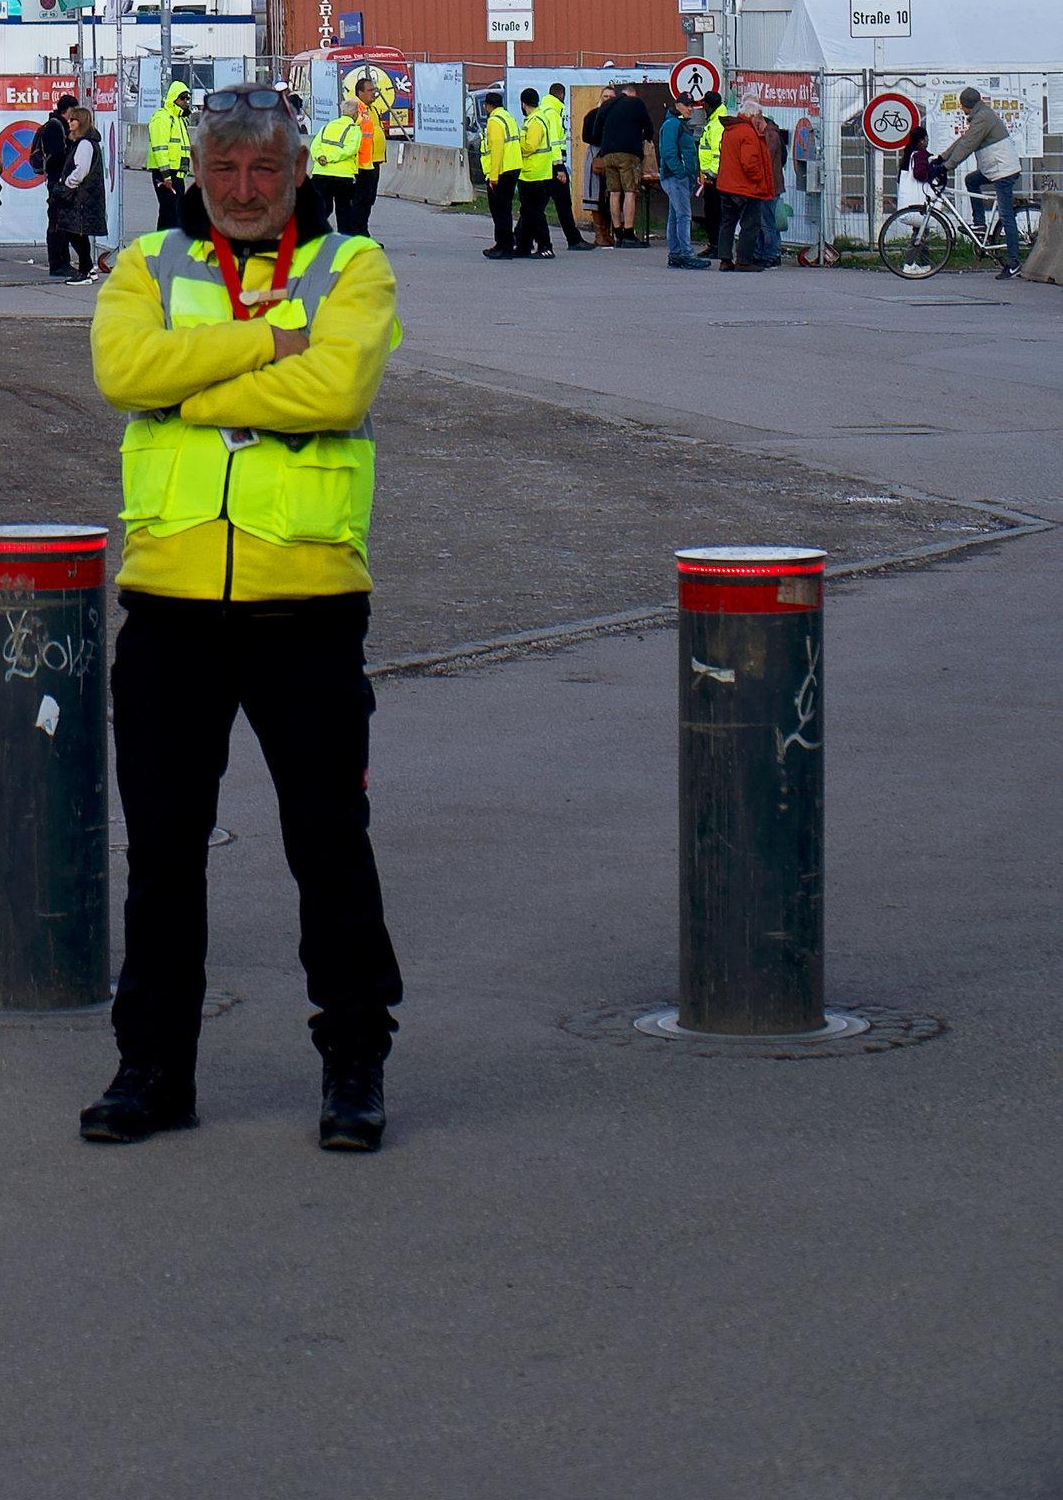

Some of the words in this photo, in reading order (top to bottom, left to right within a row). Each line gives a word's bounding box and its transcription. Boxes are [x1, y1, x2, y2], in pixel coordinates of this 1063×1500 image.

[853, 11, 890, 25] Straße
[897, 10, 908, 24] 10
[492, 21, 520, 31] Straße
[524, 21, 529, 31] 9
[6, 86, 39, 104] Exit
